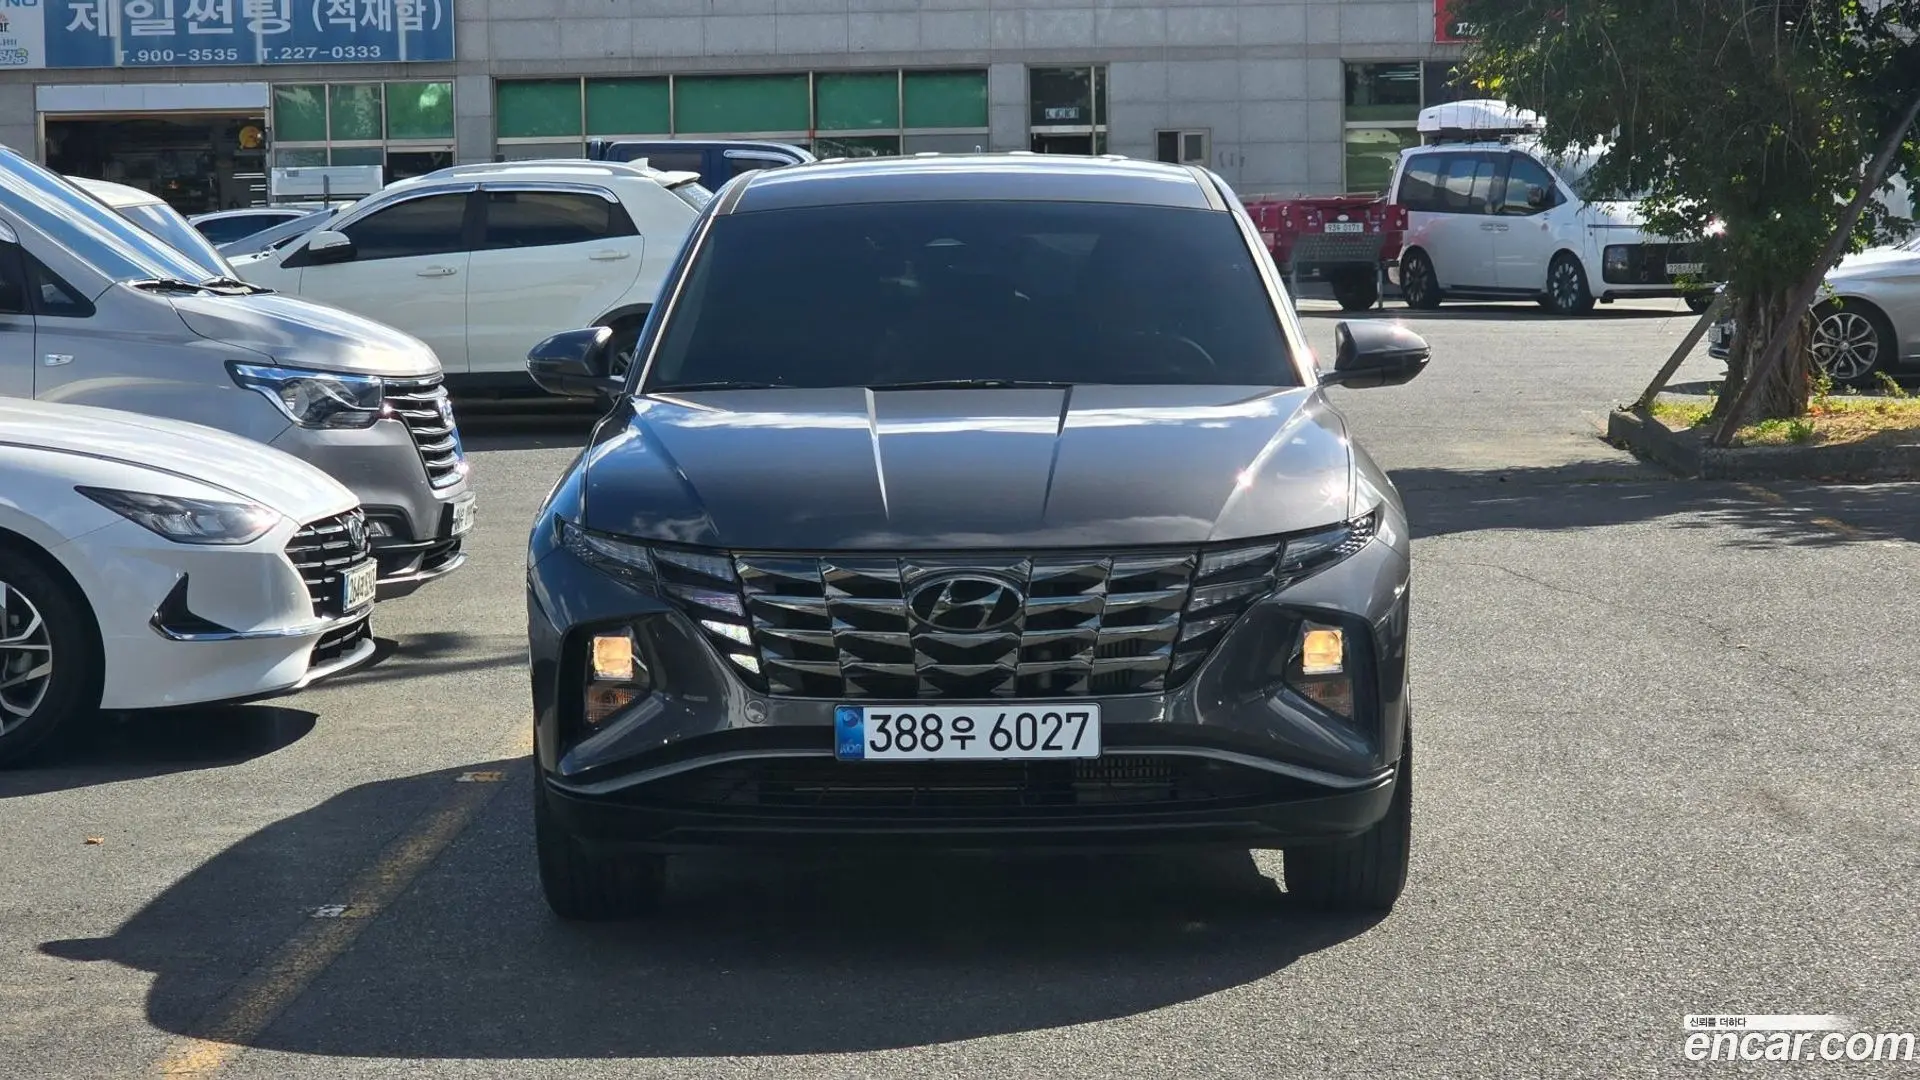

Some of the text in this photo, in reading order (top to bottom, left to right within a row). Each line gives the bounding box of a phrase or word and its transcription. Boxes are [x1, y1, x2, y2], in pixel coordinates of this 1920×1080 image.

[65, 0, 291, 37] 제일썬팅
[120, 46, 382, 63] T.900-3535 T.227-0333
[868, 712, 1090, 753] 388우 6027
